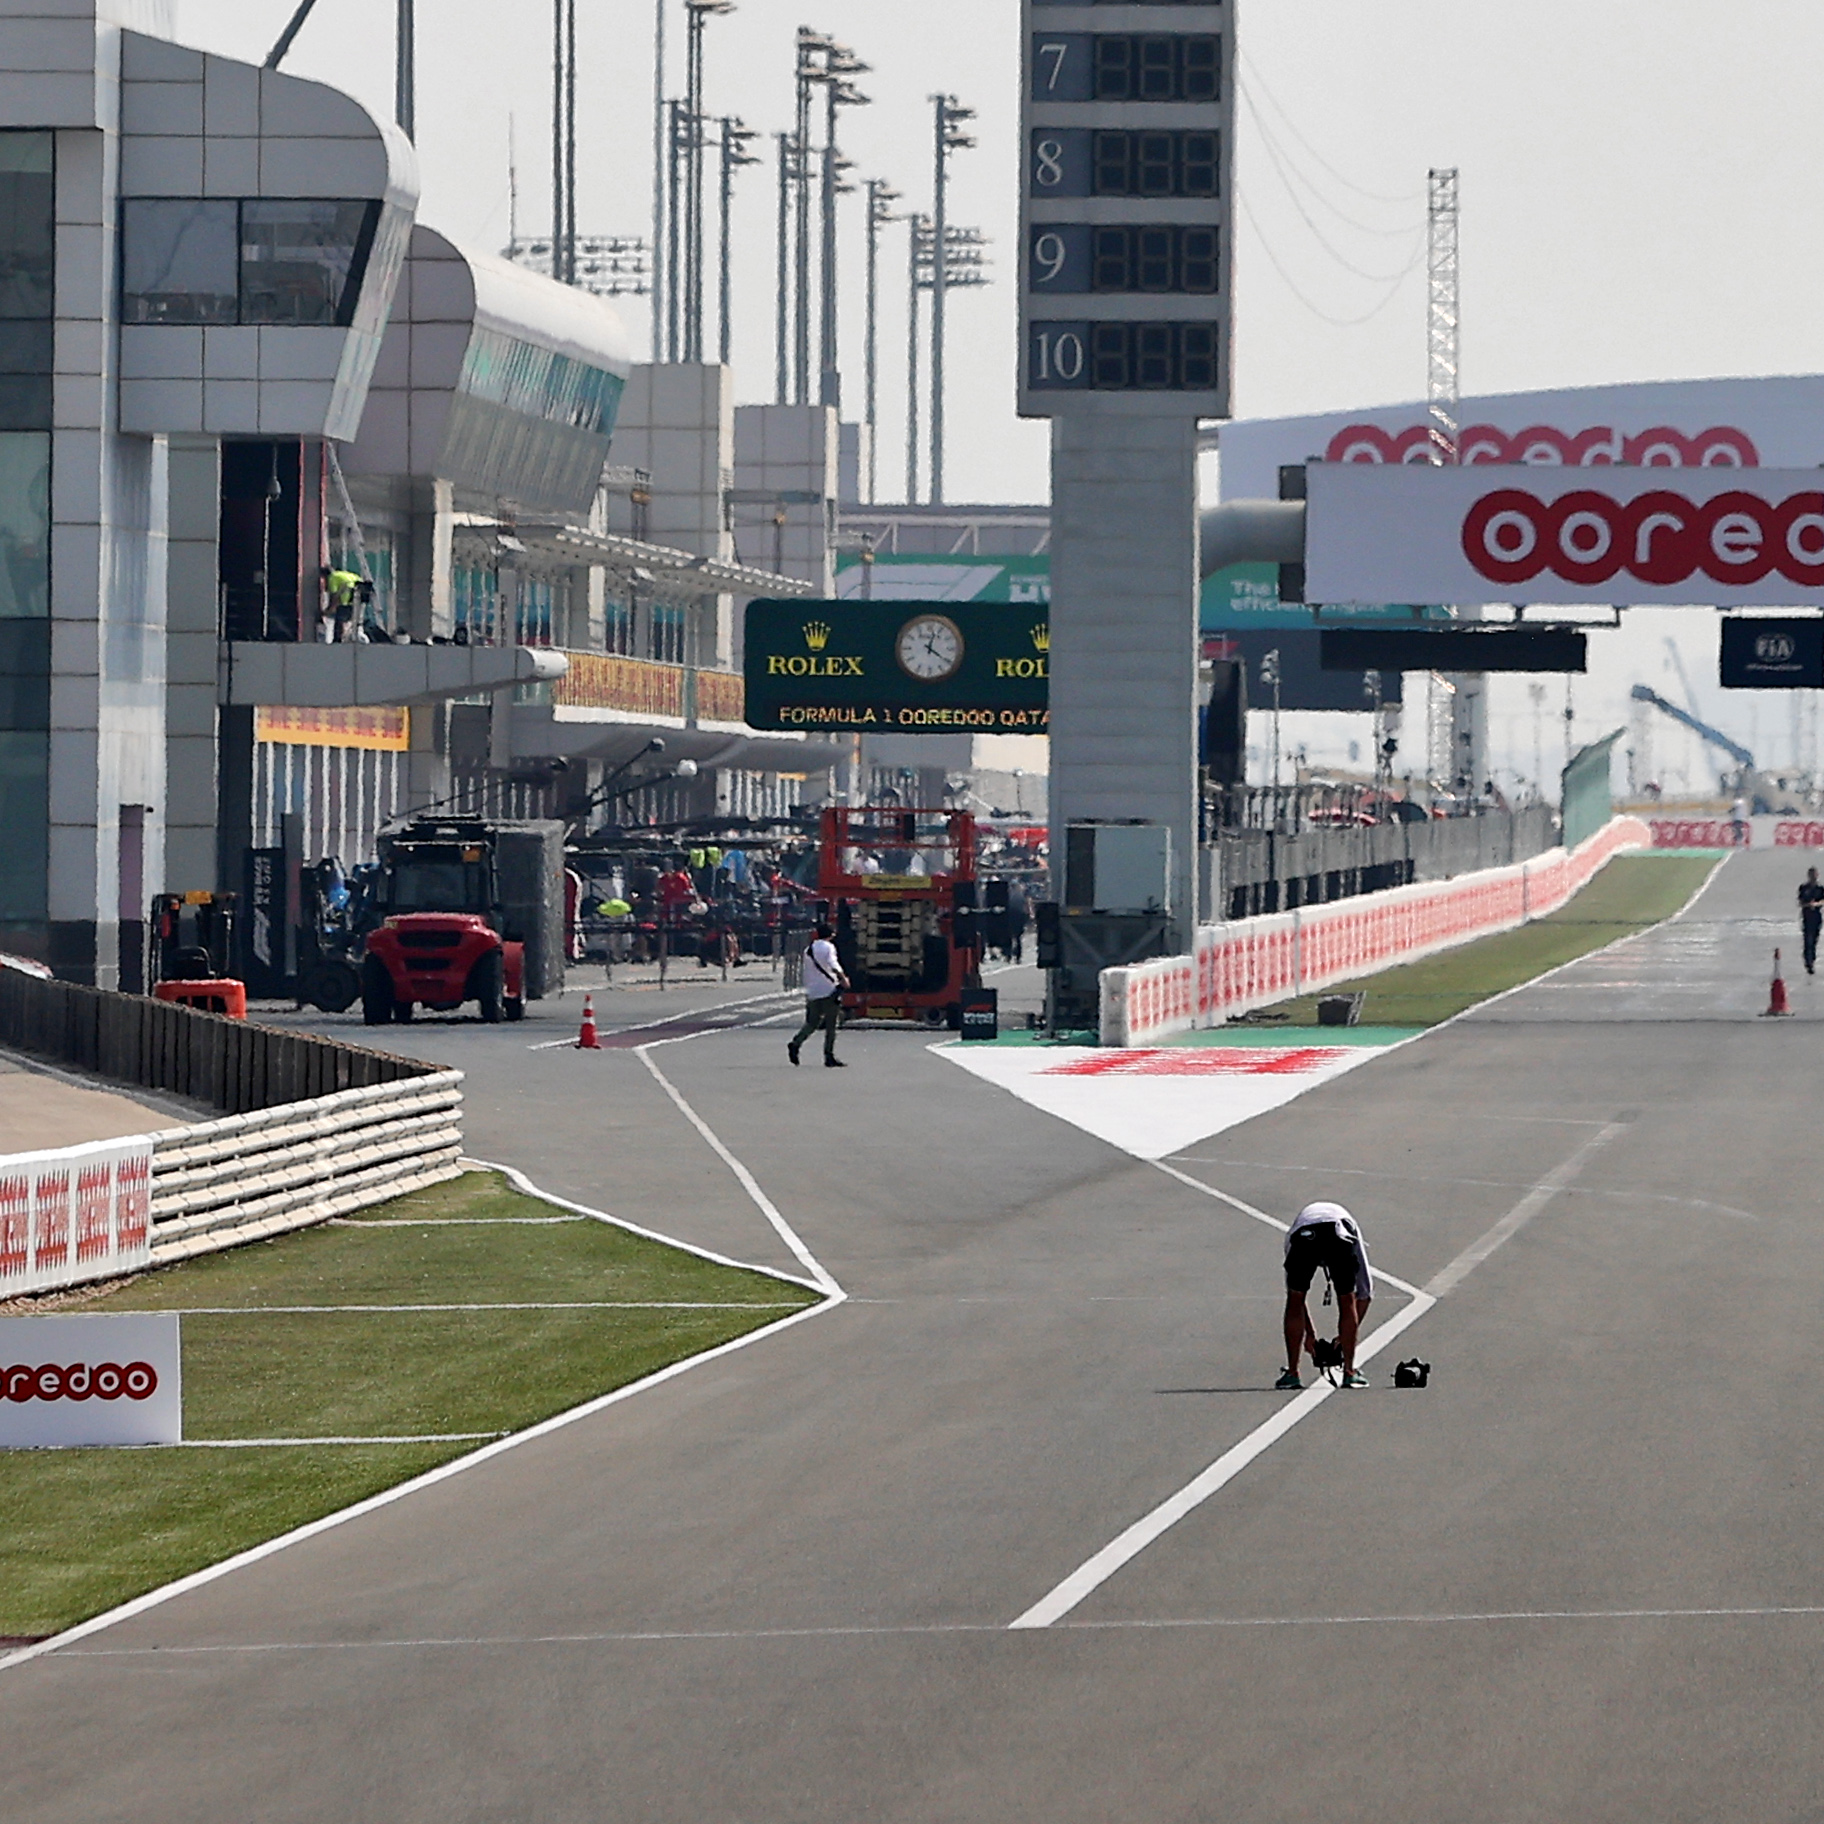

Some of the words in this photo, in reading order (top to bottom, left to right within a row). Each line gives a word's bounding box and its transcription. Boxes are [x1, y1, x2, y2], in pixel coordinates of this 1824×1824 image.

[1038, 43, 1068, 91] 7
[1035, 140, 1064, 187] 8
[1034, 232, 1066, 283] 9
[1034, 332, 1084, 380] 10
[766, 655, 865, 677] ROLEX
[994, 658, 1051, 679] ROL
[778, 706, 877, 724] FORMULA
